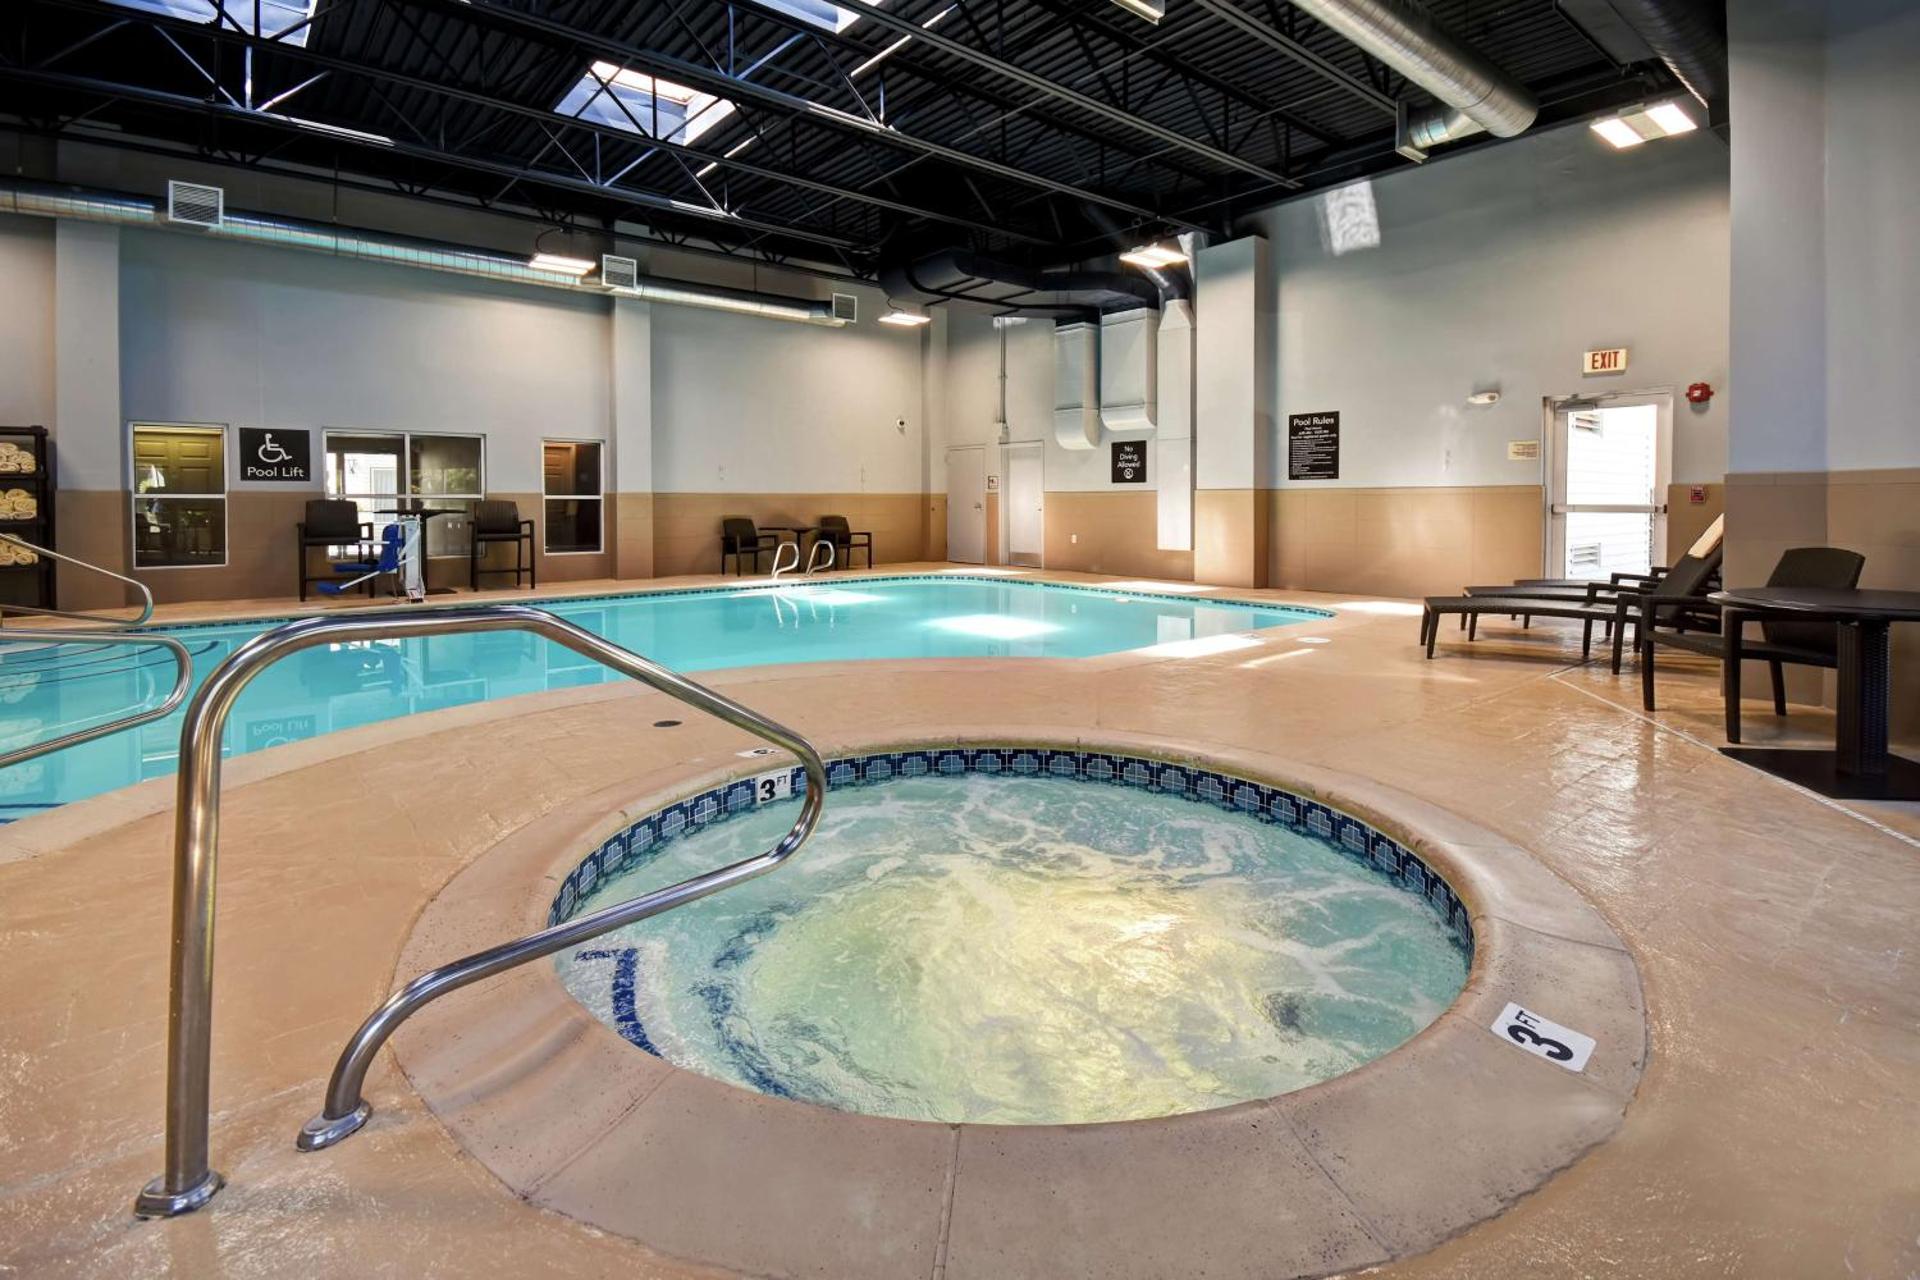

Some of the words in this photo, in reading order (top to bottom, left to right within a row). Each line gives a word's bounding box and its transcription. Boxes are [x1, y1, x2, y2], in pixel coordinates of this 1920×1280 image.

[1591, 351, 1619, 370] EXIT
[1293, 417, 1311, 426] Pool
[1312, 415, 1335, 425] Rules
[1119, 453, 1139, 461] Diving
[247, 466, 278, 477] Pool
[282, 466, 304, 477] Lift
[760, 779, 776, 802] 3
[777, 775, 788, 787] FT
[1515, 1010, 1541, 1030] FT
[1507, 1024, 1574, 1061] 3
